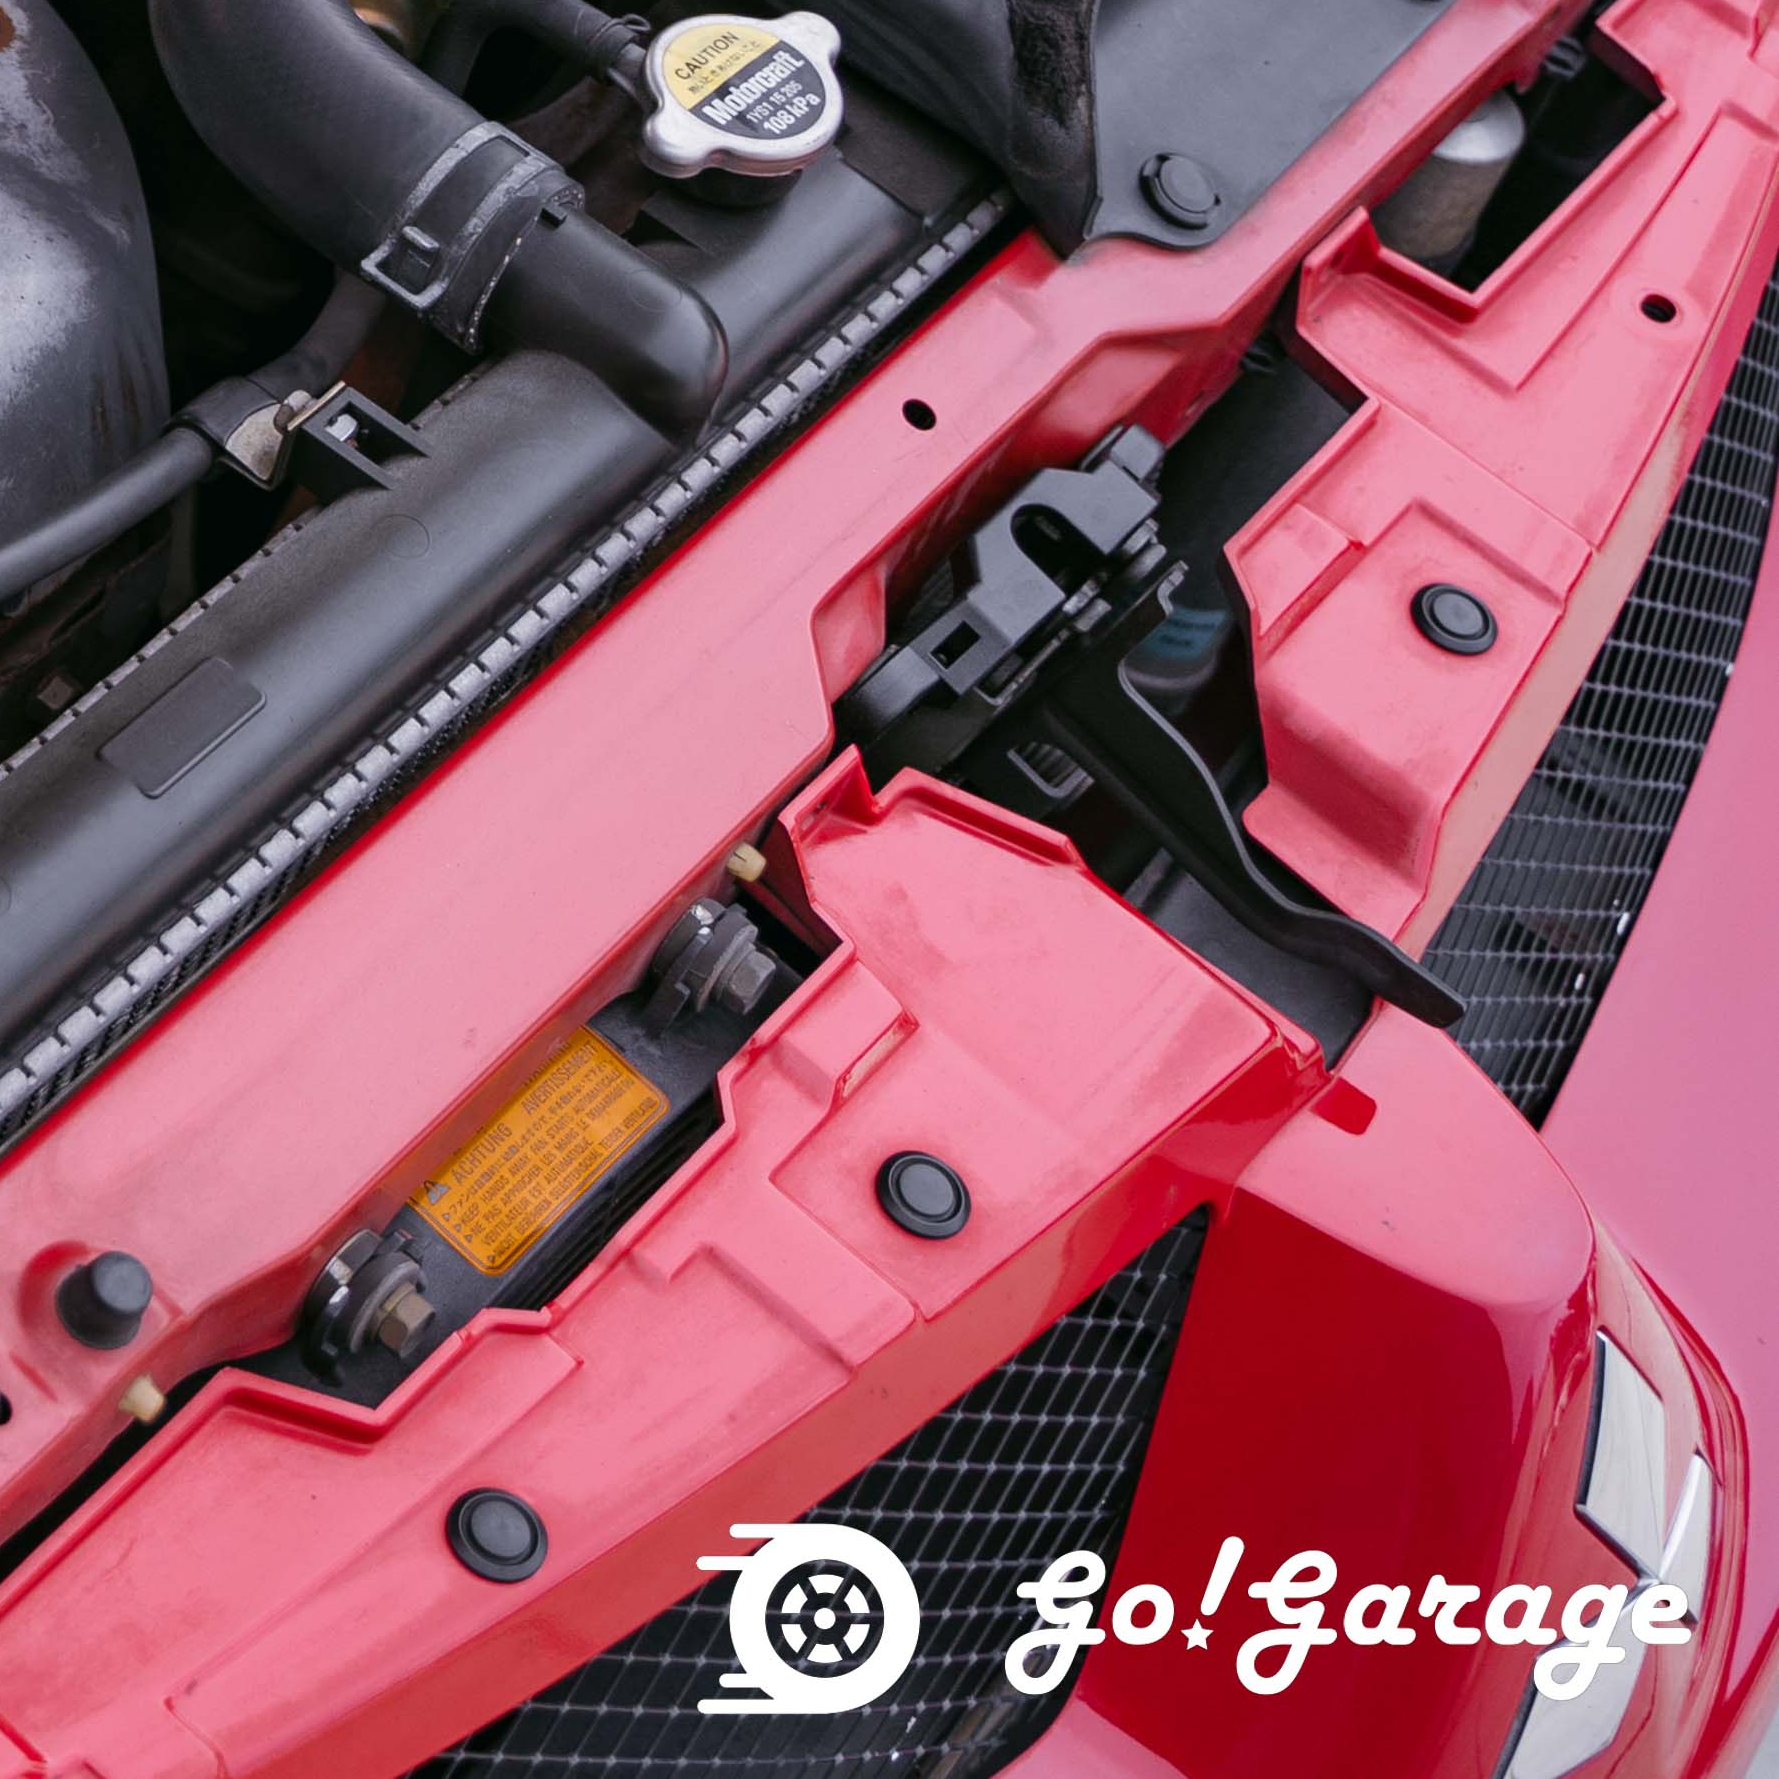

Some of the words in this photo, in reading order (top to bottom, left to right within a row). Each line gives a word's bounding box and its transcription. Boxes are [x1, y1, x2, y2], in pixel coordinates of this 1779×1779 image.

[674, 31, 740, 80] CAUTION
[702, 50, 805, 125] Motorcraft
[763, 109, 796, 134] 108
[789, 93, 821, 120] kPa
[448, 1121, 513, 1184] ACHTUNG
[519, 1039, 599, 1115] AVERTISSEMENT
